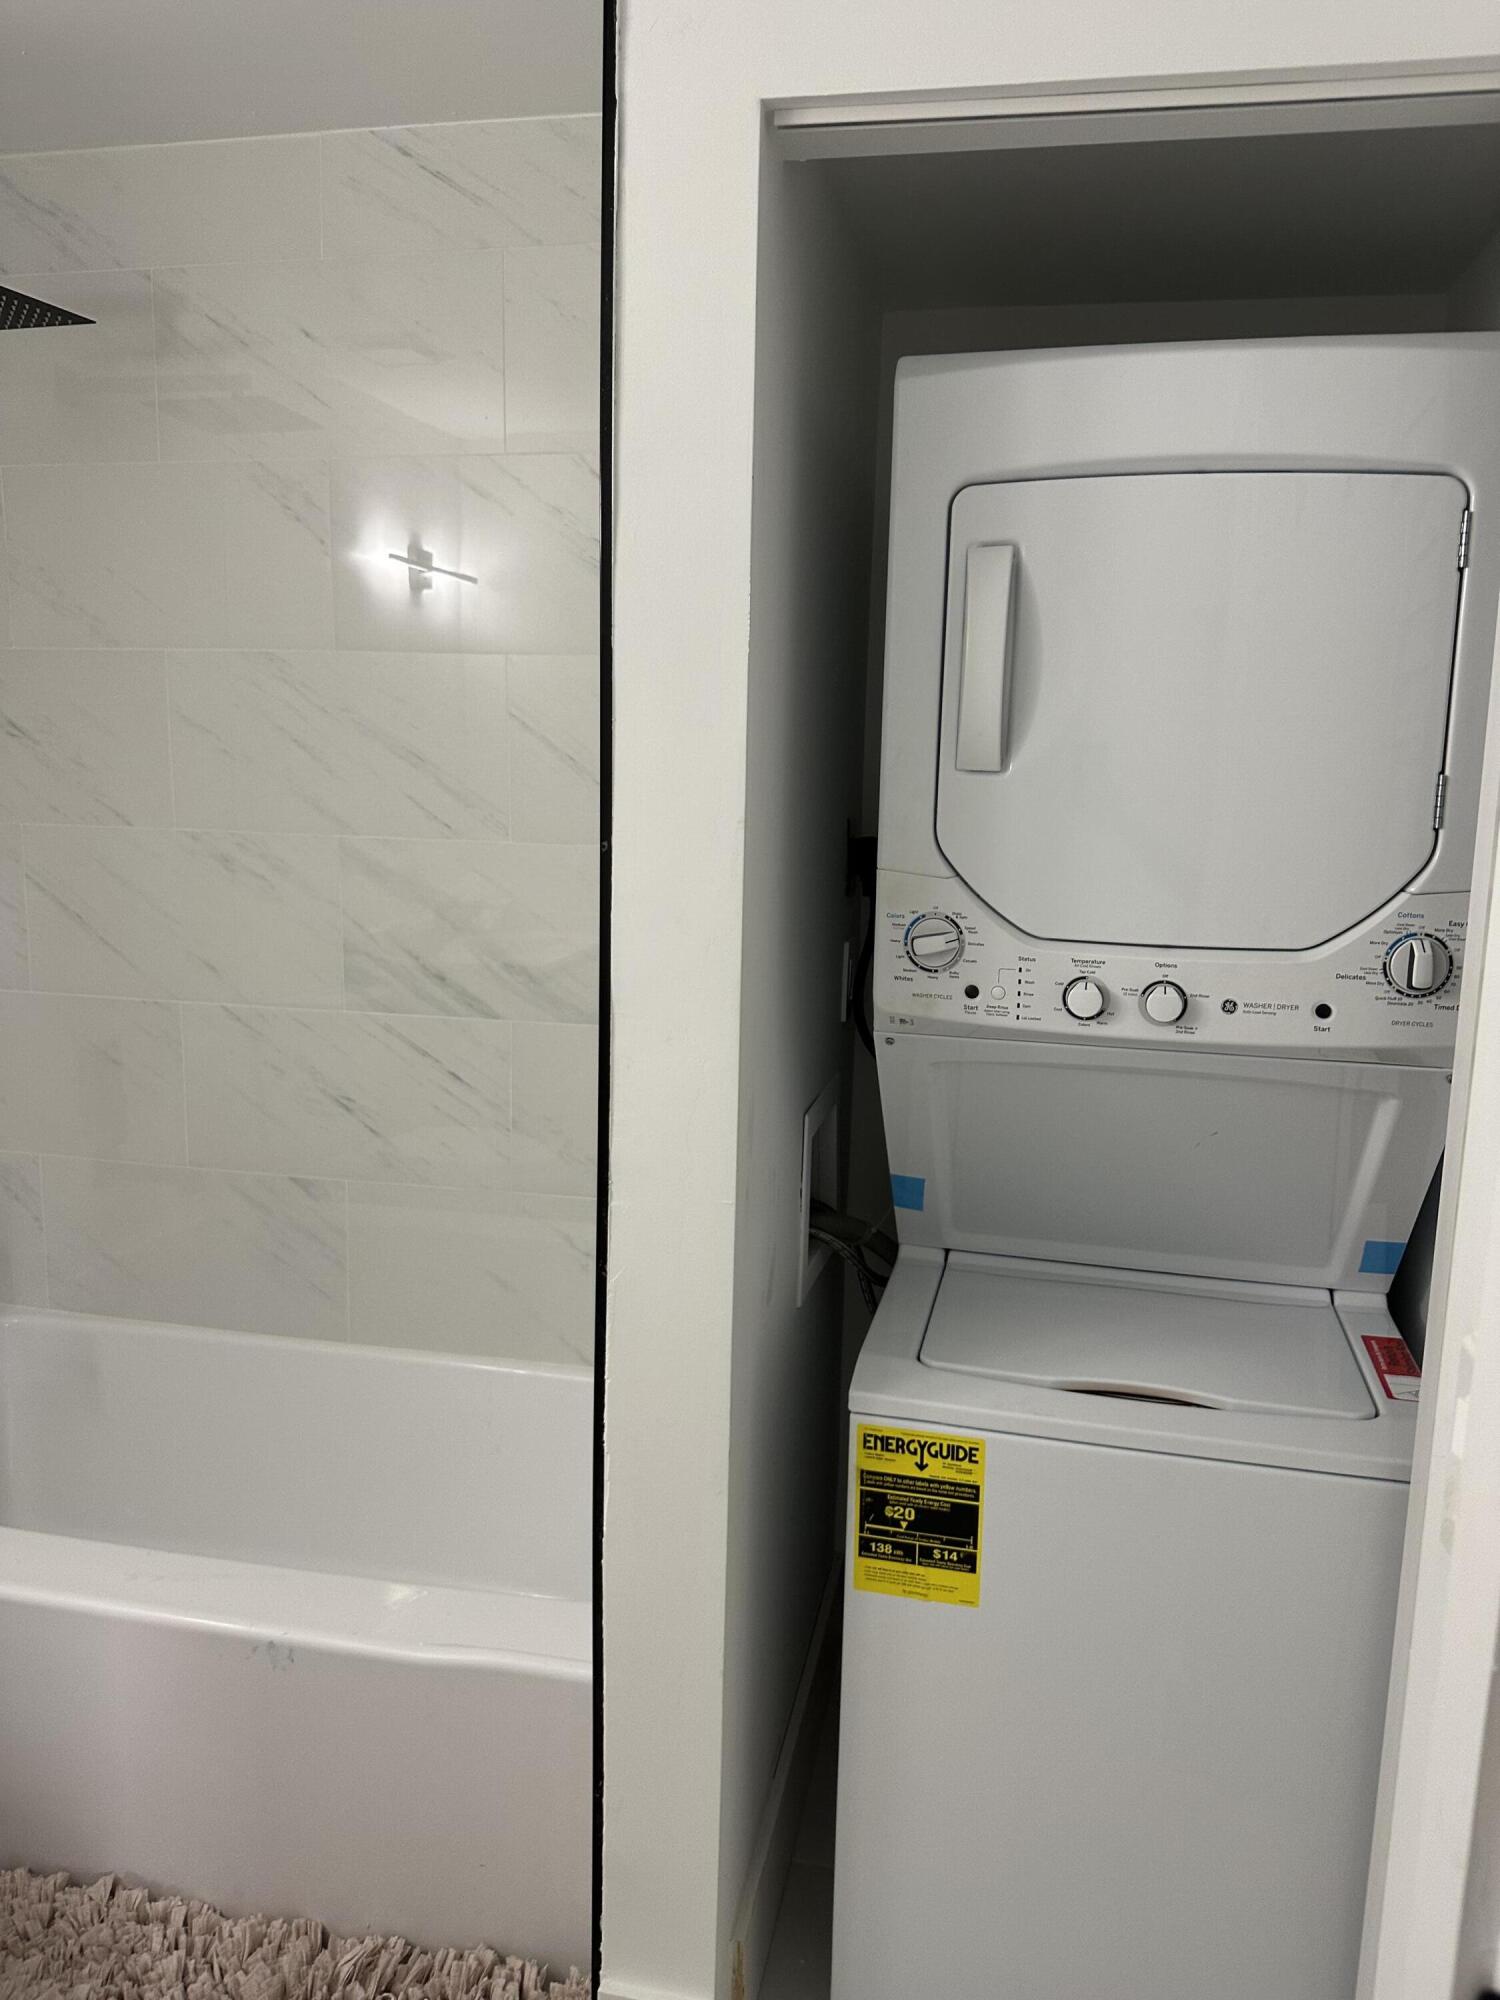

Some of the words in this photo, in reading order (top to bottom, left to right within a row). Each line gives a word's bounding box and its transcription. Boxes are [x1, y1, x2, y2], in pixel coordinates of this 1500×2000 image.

[1397, 911, 1425, 919] Cottons
[1448, 921, 1464, 929] Easy
[1335, 973, 1367, 981] Delicates
[1276, 1003, 1300, 1011] DRYER
[1411, 1020, 1434, 1028] CYCLES
[863, 1432, 980, 1466] ENERGYGUIDE
[940, 1483, 955, 1491] yellow
[884, 1505, 916, 1521] $20
[870, 1542, 892, 1554] 138
[933, 1548, 958, 1561] $14
